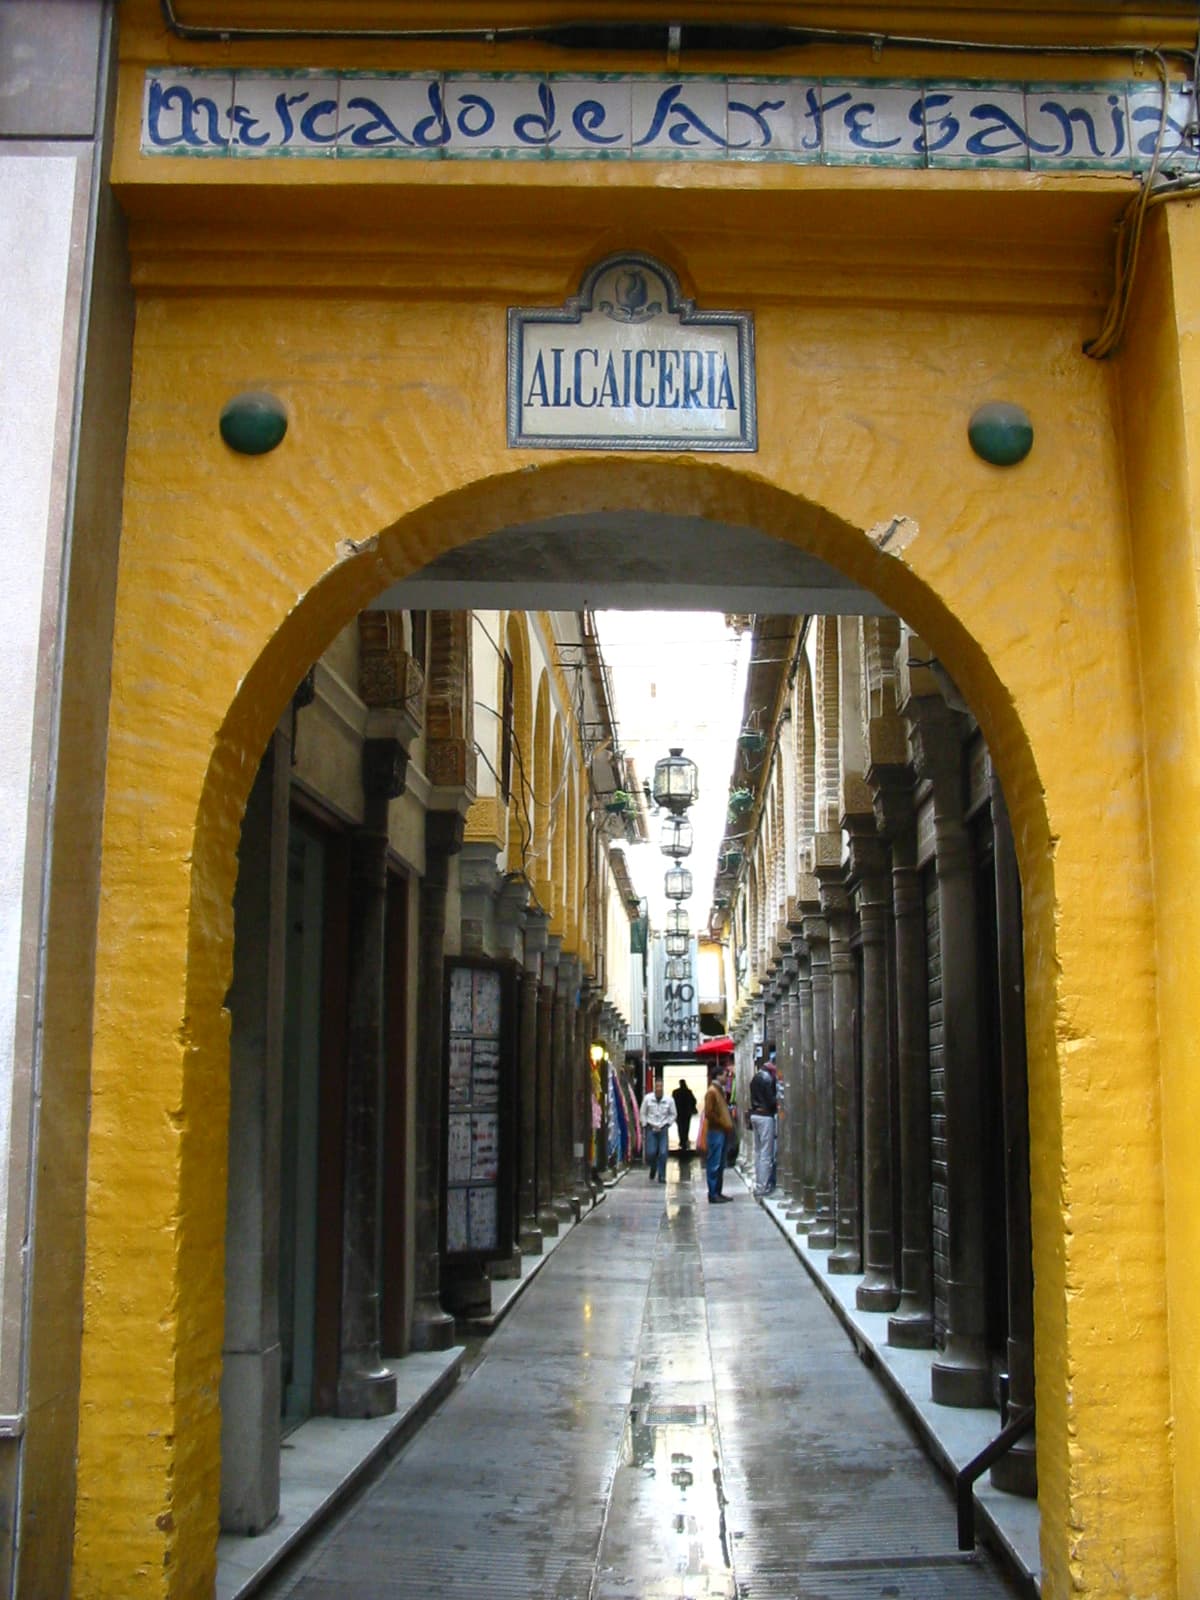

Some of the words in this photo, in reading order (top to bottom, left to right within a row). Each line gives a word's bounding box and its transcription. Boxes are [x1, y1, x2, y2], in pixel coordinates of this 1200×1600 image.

[149, 79, 495, 147] Mercado
[513, 82, 624, 144] de
[523, 348, 738, 410] ALCAICERIA
